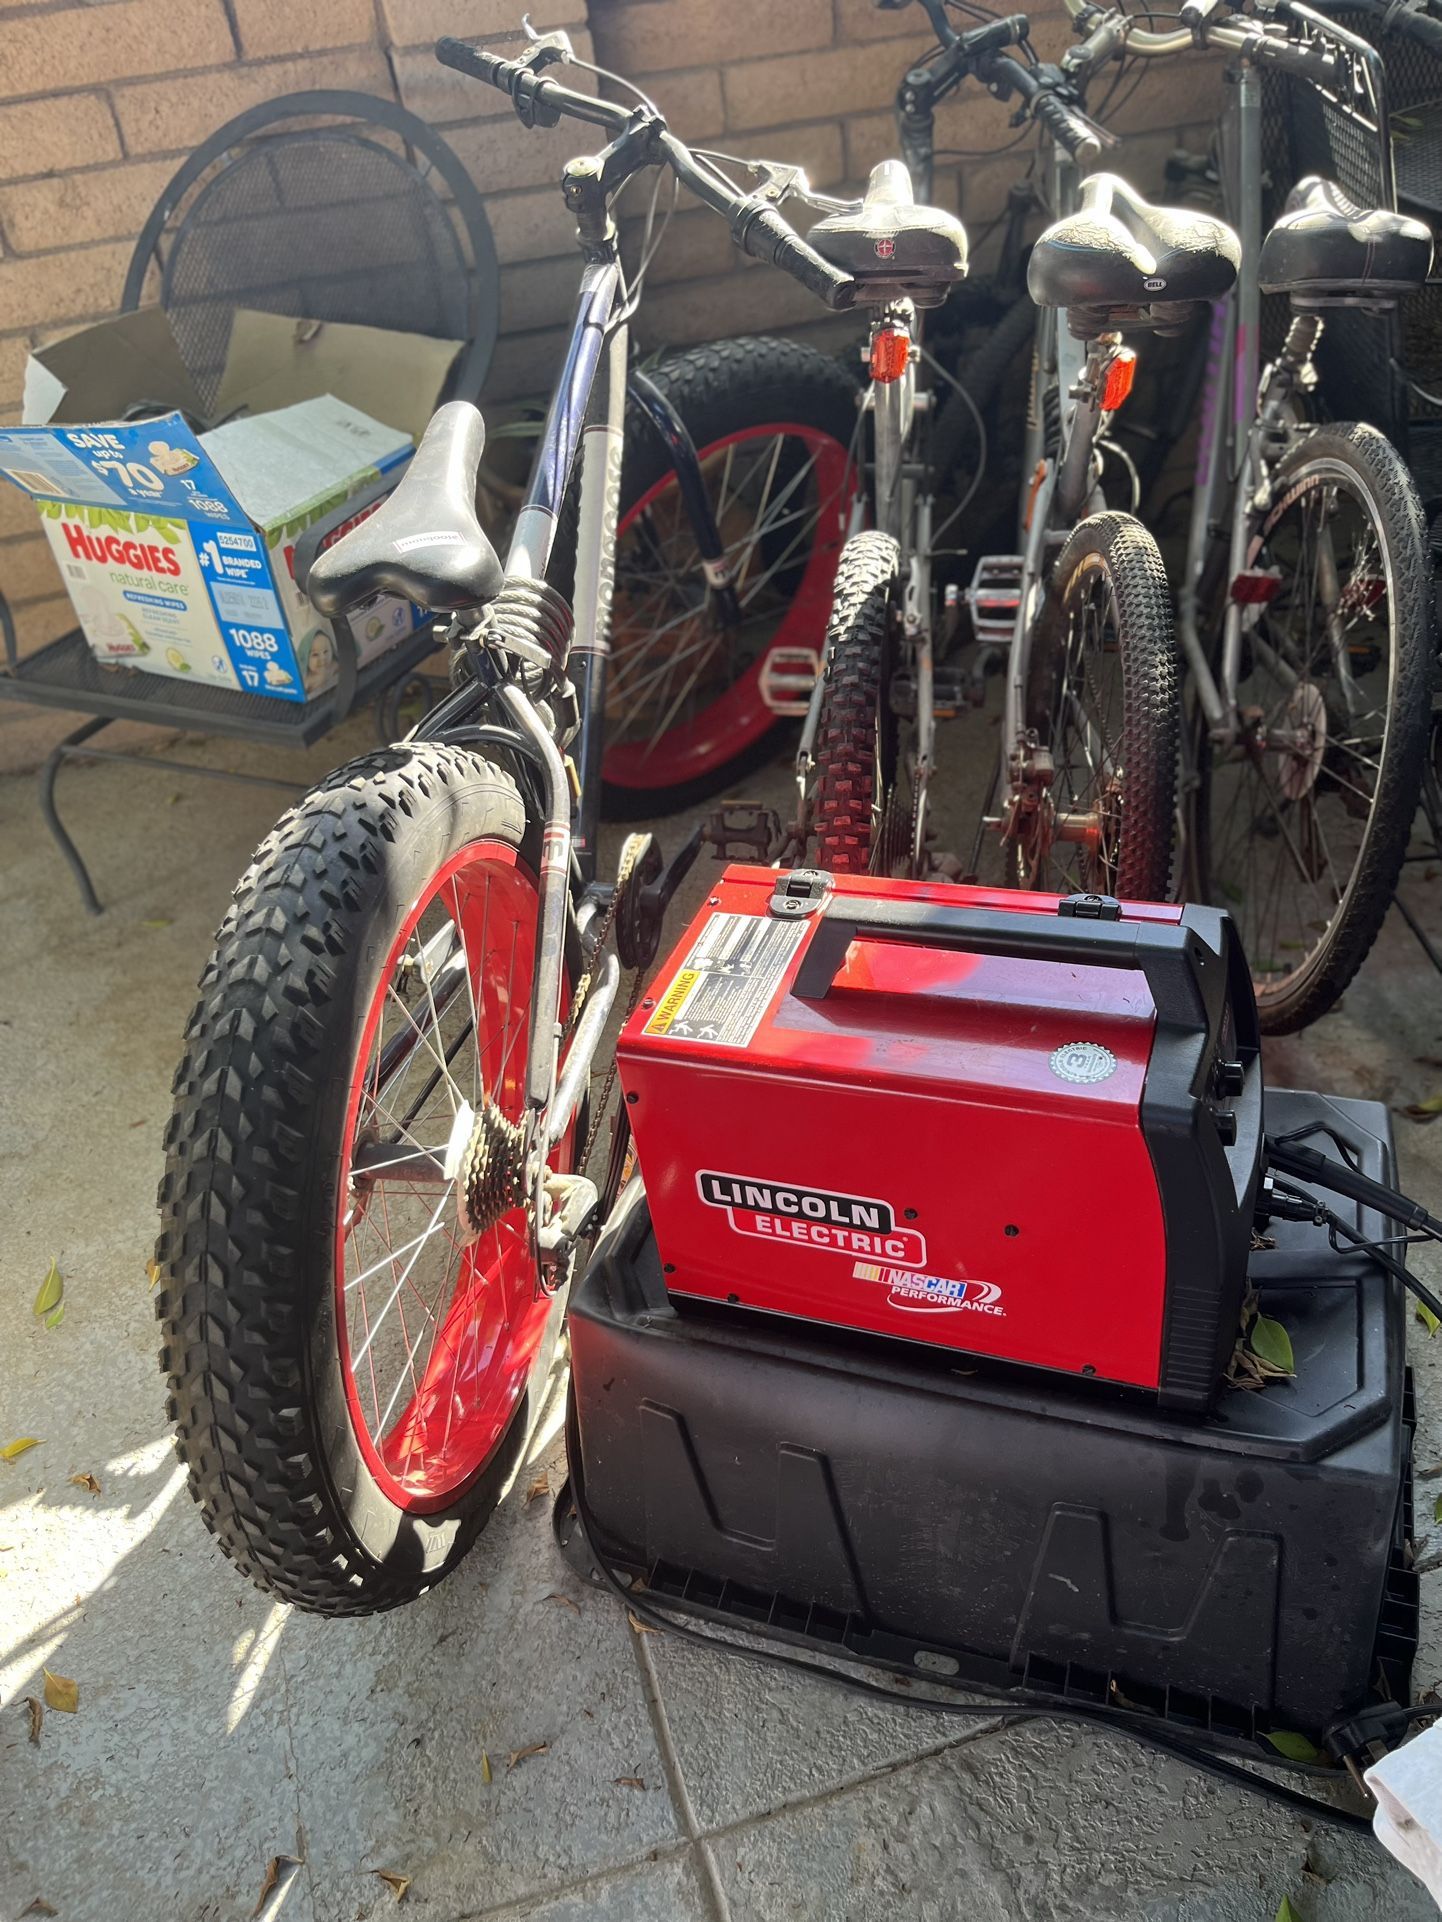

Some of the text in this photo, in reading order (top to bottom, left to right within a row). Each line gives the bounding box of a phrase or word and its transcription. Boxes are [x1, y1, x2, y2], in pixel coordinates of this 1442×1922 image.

[66, 432, 126, 450] SAVE
[92, 449, 124, 460] up to
[91, 460, 165, 491] $70
[180, 479, 196, 491] 17
[189, 499, 229, 513] 1088
[61, 522, 181, 577] HUGGIES
[198, 540, 224, 574] #1
[222, 555, 262, 569] BRANDED
[110, 571, 188, 596] natural care
[228, 628, 279, 652] 1088
[245, 648, 271, 660] WIPES
[241, 670, 260, 687] 17
[657, 972, 695, 1025] WARNING
[711, 1179, 879, 1229] LINCOLN
[755, 1214, 906, 1257] ELECTRIC
[888, 1269, 961, 1299] NASCAR
